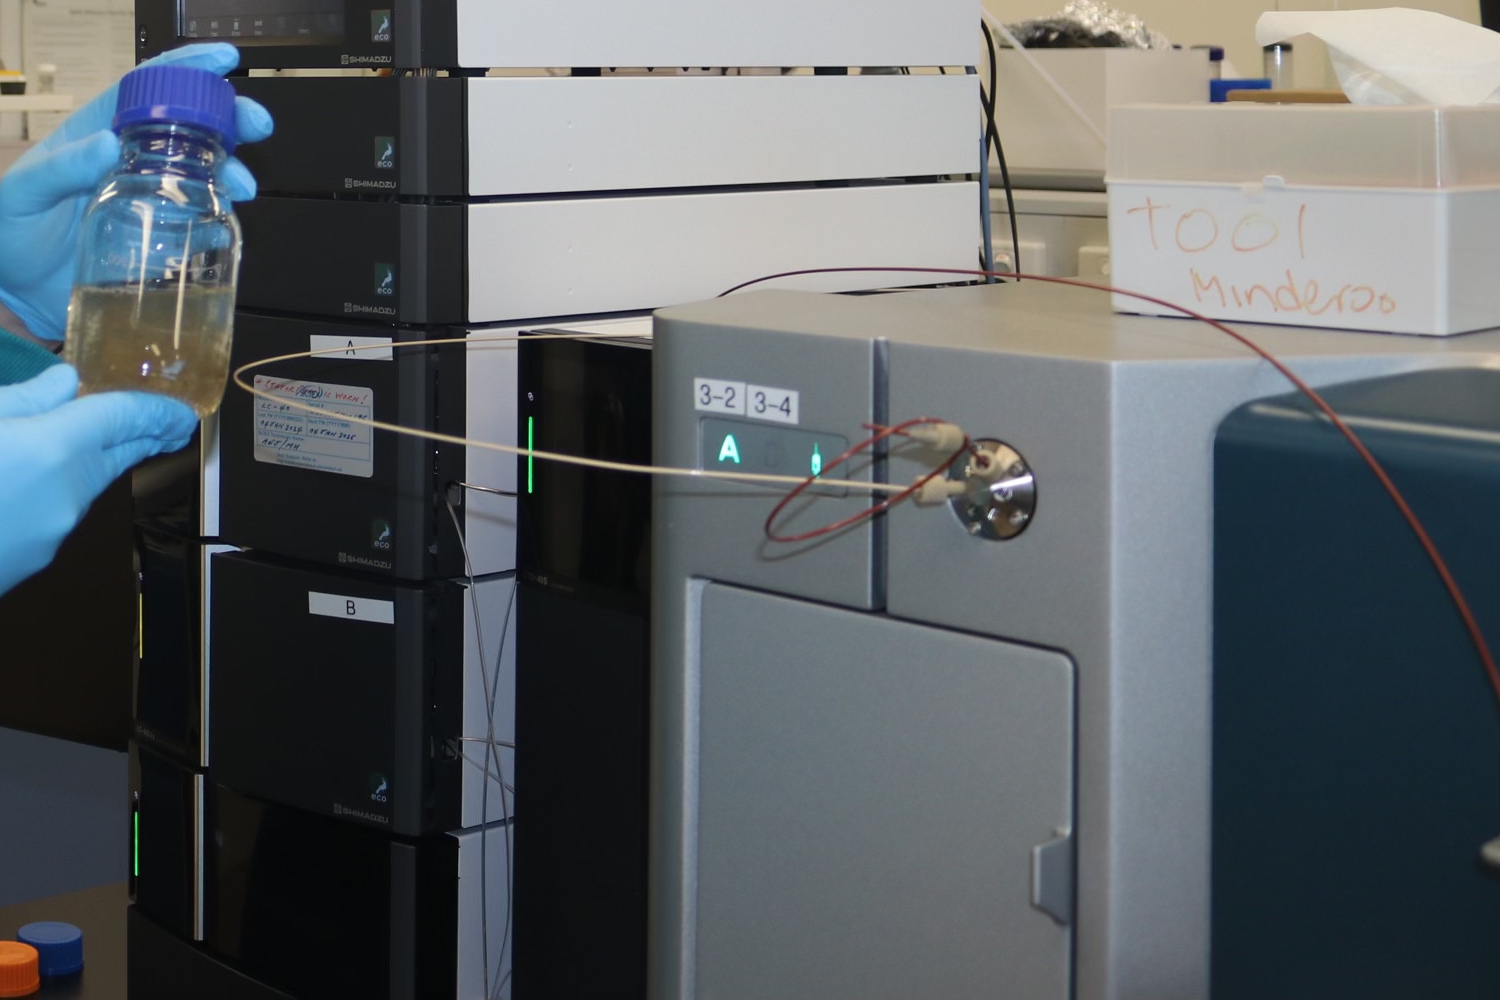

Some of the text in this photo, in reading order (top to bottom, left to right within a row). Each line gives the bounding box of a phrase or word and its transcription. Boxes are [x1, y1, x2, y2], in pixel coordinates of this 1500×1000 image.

[374, 33, 389, 41] eco
[349, 55, 392, 63] SHIMADZU
[377, 160, 393, 168] eco
[353, 180, 396, 188] SHIMADZU
[377, 287, 392, 295] eco
[1189, 267, 1396, 315] Minderoo
[352, 304, 396, 315] SHIMADZU
[345, 340, 356, 355] A
[699, 383, 791, 418] 3-2 3-4
[718, 433, 741, 464] A
[374, 541, 390, 549] eco
[347, 555, 392, 569] SHIMADZU
[346, 600, 356, 616] B
[371, 793, 387, 802] eco
